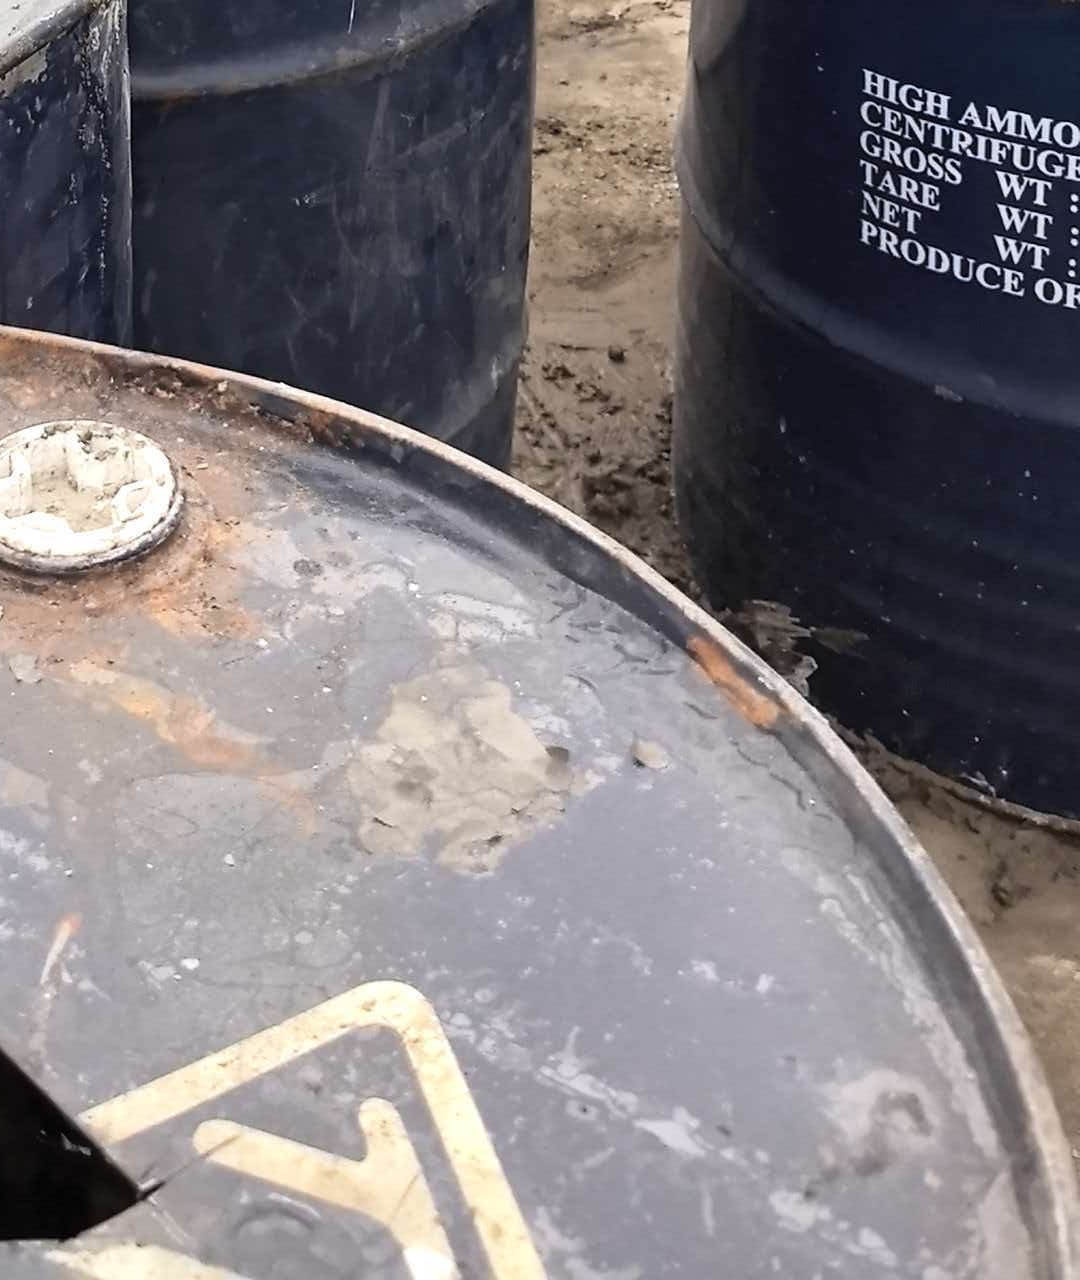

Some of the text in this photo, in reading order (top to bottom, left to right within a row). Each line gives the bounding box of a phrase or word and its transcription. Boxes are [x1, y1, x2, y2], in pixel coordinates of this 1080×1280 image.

[862, 68, 1080, 149] HIGH AMMO
[859, 130, 963, 186] GROSS
[995, 170, 1052, 207] WT
[860, 159, 941, 212] TARE
[996, 203, 1053, 240] WT
[859, 219, 1025, 297] PRODUCE
[861, 190, 922, 235] NET
[993, 234, 1050, 271] WT
